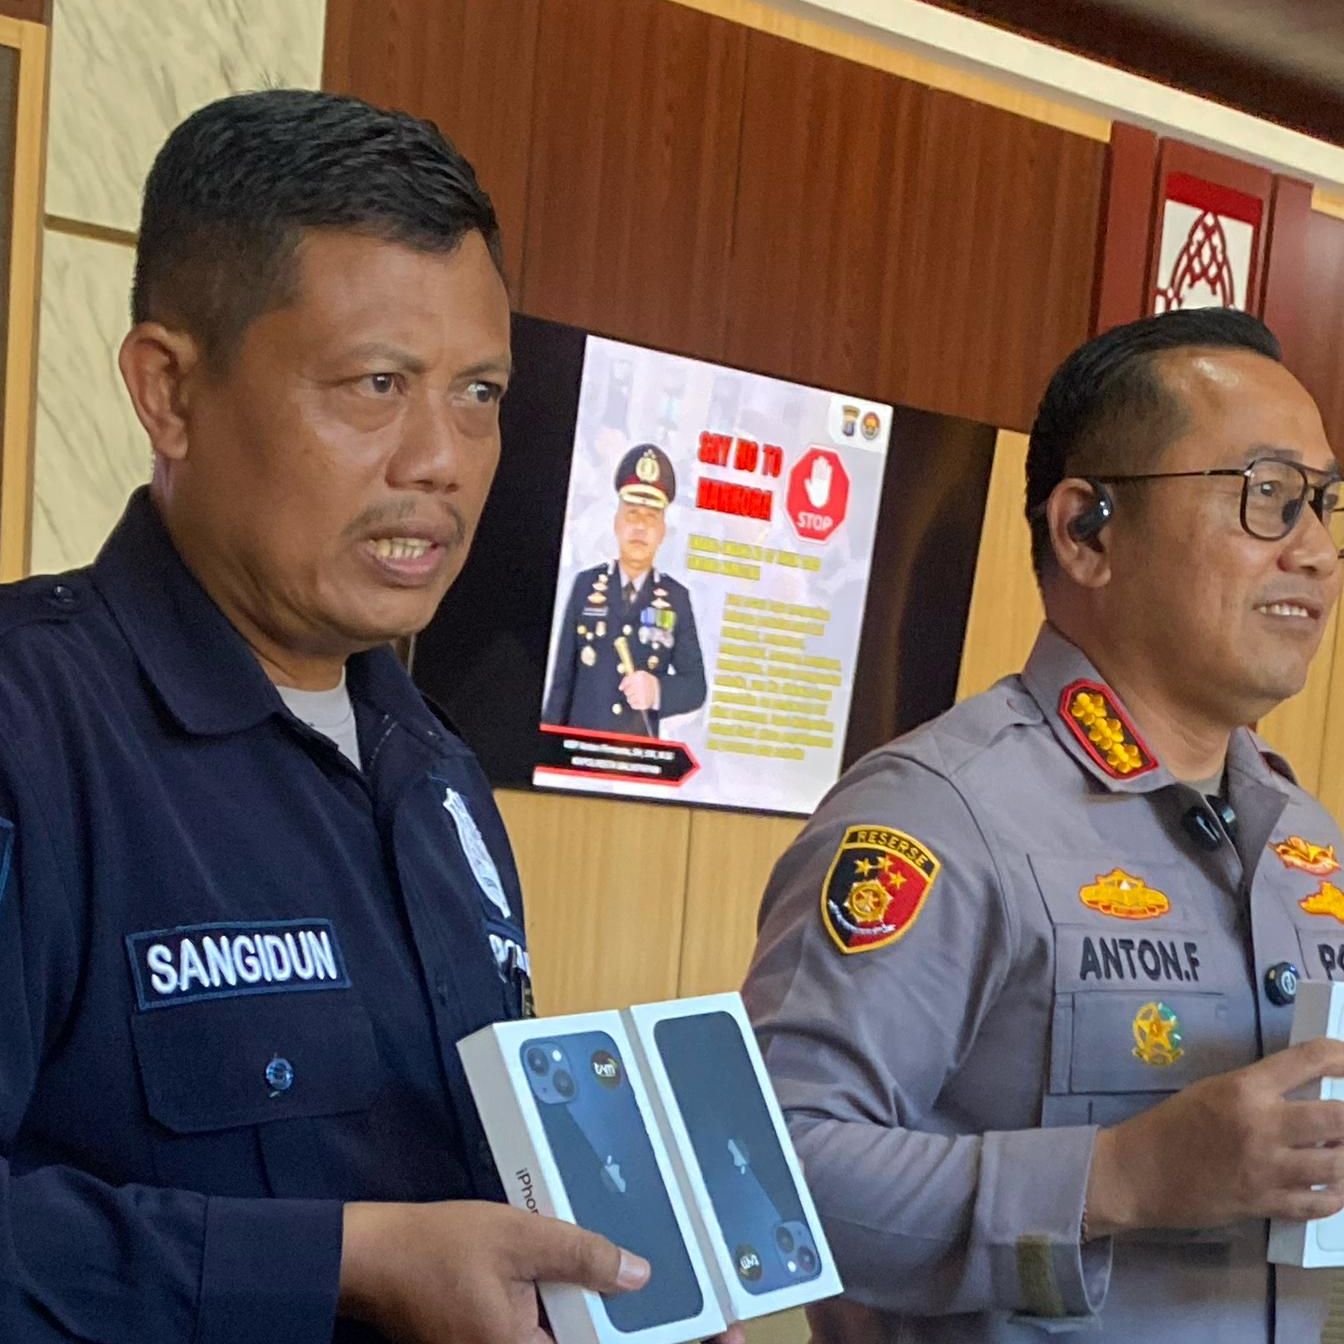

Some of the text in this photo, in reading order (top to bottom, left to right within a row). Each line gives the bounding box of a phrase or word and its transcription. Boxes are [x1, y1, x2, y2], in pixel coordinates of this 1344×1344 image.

[797, 512, 833, 530] STOP
[857, 831, 928, 868] RESERSE
[147, 931, 337, 994] SANGIDUN
[1079, 936, 1201, 982] ANTON.F
[515, 1168, 540, 1214] iPho
